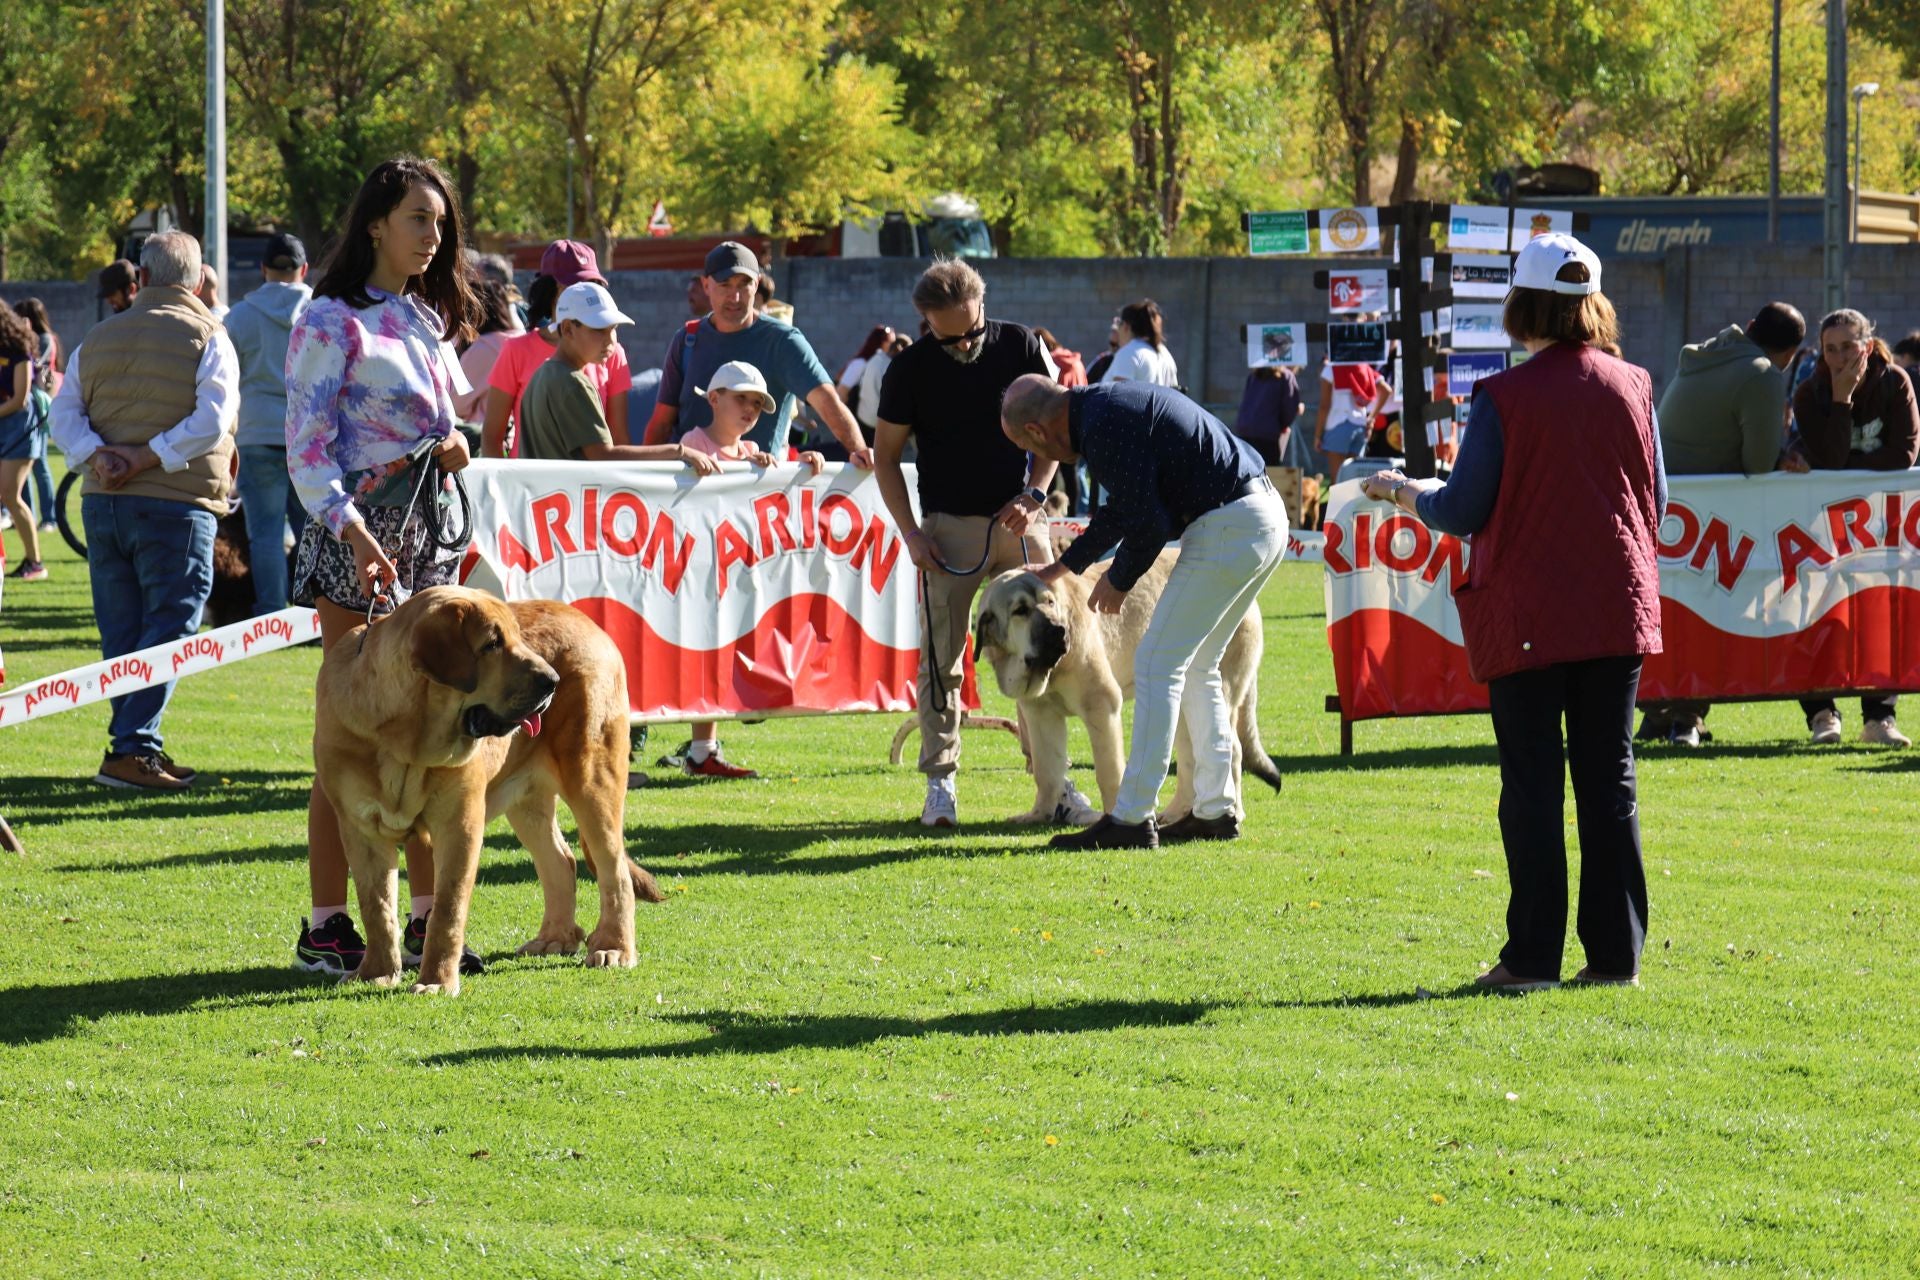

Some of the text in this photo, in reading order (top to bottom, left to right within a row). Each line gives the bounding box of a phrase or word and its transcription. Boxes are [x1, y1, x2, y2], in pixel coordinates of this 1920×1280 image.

[1252, 214, 1304, 224] BAR JOSEFINA
[497, 488, 697, 597] ARION
[715, 489, 902, 599] ARION
[1323, 514, 1470, 595] RION
[1777, 494, 1920, 594] ARI
[24, 679, 80, 714] ARION
[98, 659, 153, 694] ARION
[172, 638, 224, 673] ARION
[242, 618, 293, 652] ARION
